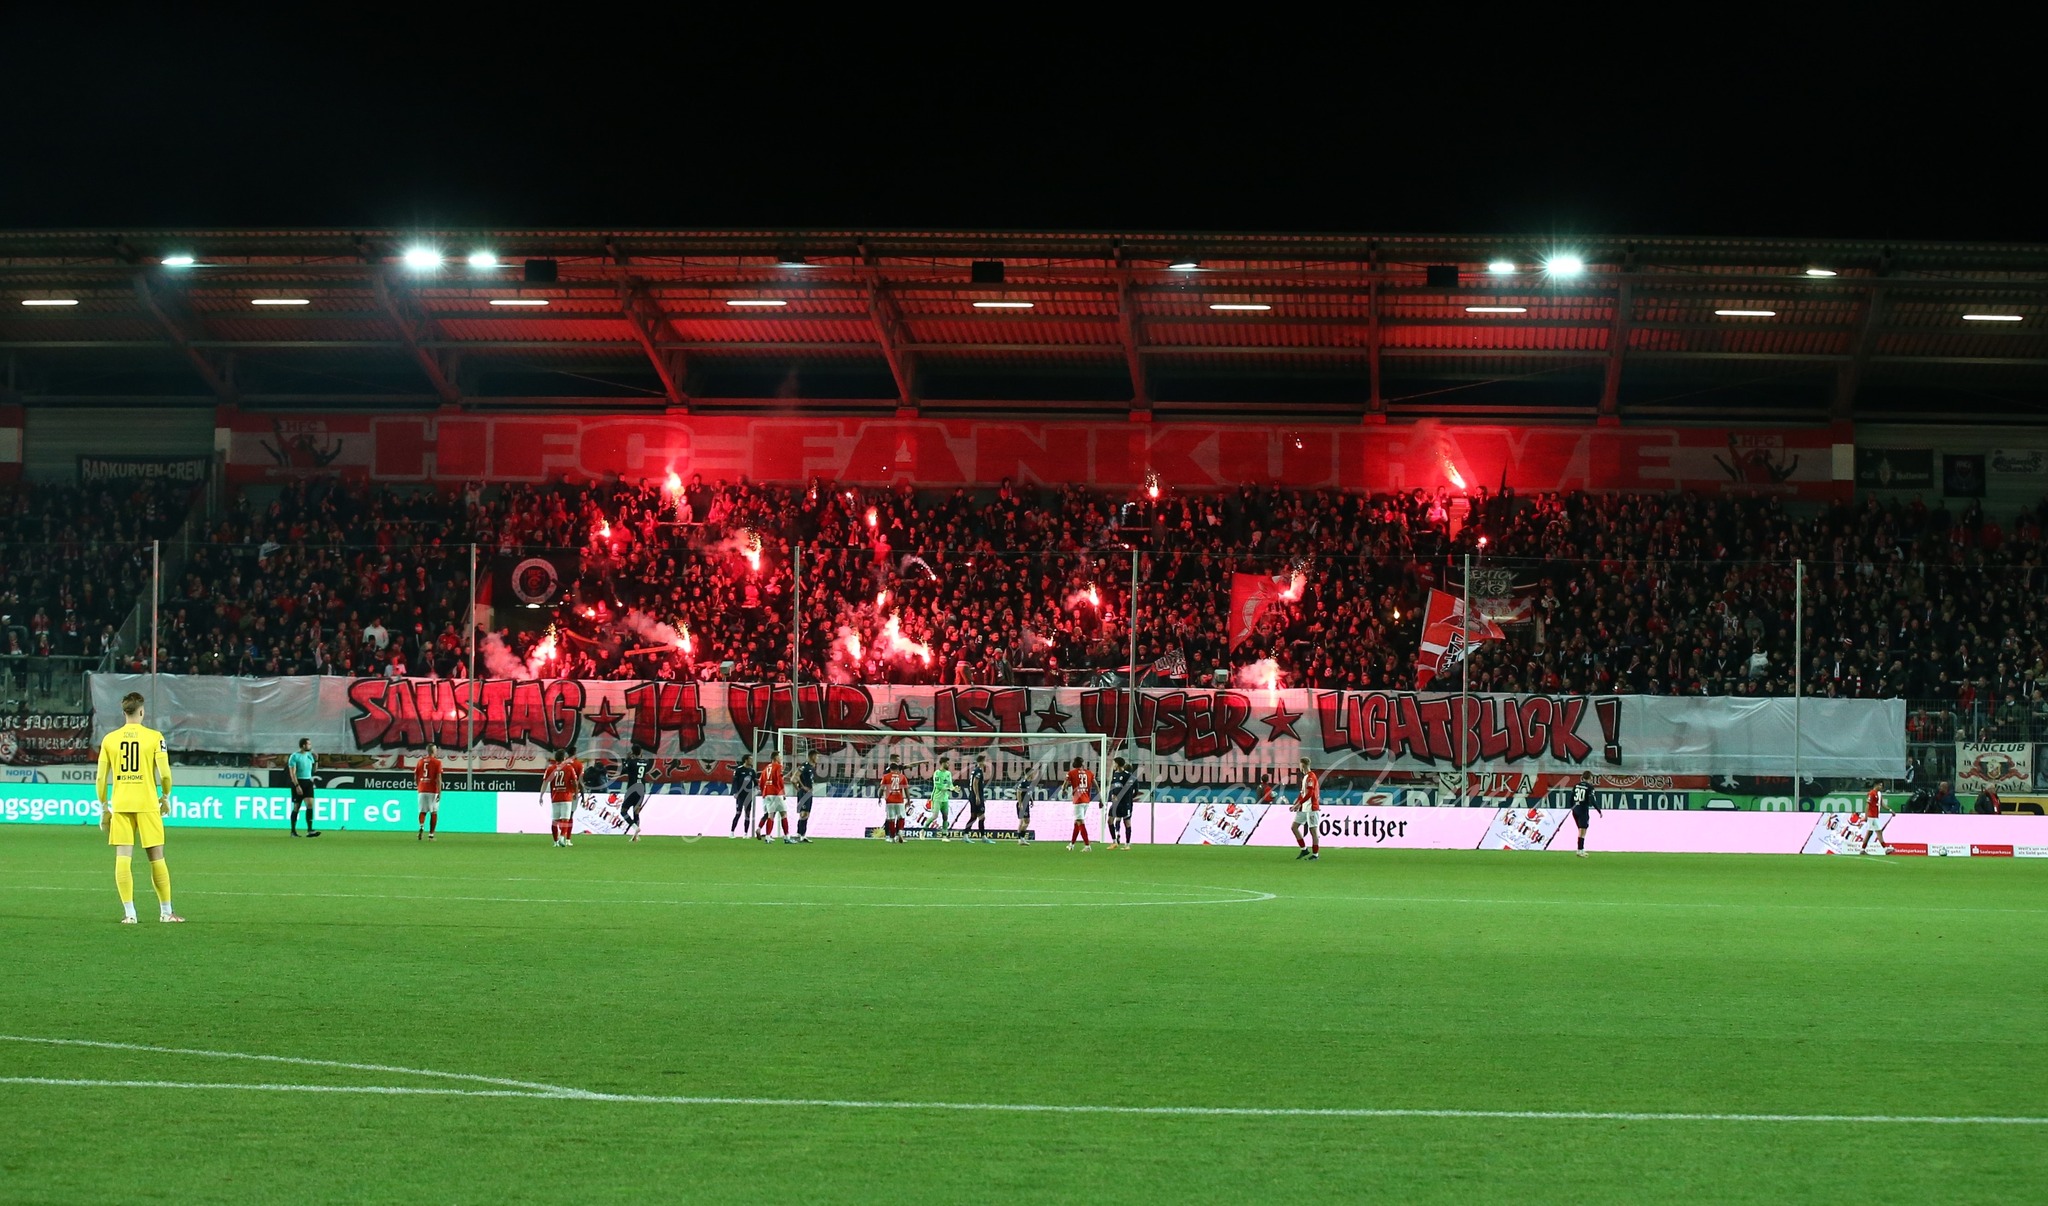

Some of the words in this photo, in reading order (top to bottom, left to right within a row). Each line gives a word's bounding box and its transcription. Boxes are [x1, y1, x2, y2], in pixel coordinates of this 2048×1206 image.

[347, 676, 585, 753] SAMSTAG
[624, 680, 706, 754] 14
[934, 685, 1034, 757] IST
[1080, 687, 1260, 761] UNSER
[1962, 742, 2026, 753] FANCLUB
[120, 741, 139, 772] 30
[62, 770, 98, 780] NOR
[218, 772, 244, 780] NORD
[423, 762, 428, 778] 5
[637, 766, 645, 778] 9
[554, 770, 565, 786] 22
[1078, 773, 1088, 788] 33
[1642, 775, 1673, 788] 1984
[454, 780, 486, 791] suht
[487, 780, 516, 791] dich!
[1573, 788, 1586, 802] 30
[363, 800, 400, 822] eG
[1303, 813, 1408, 843] östritzer
